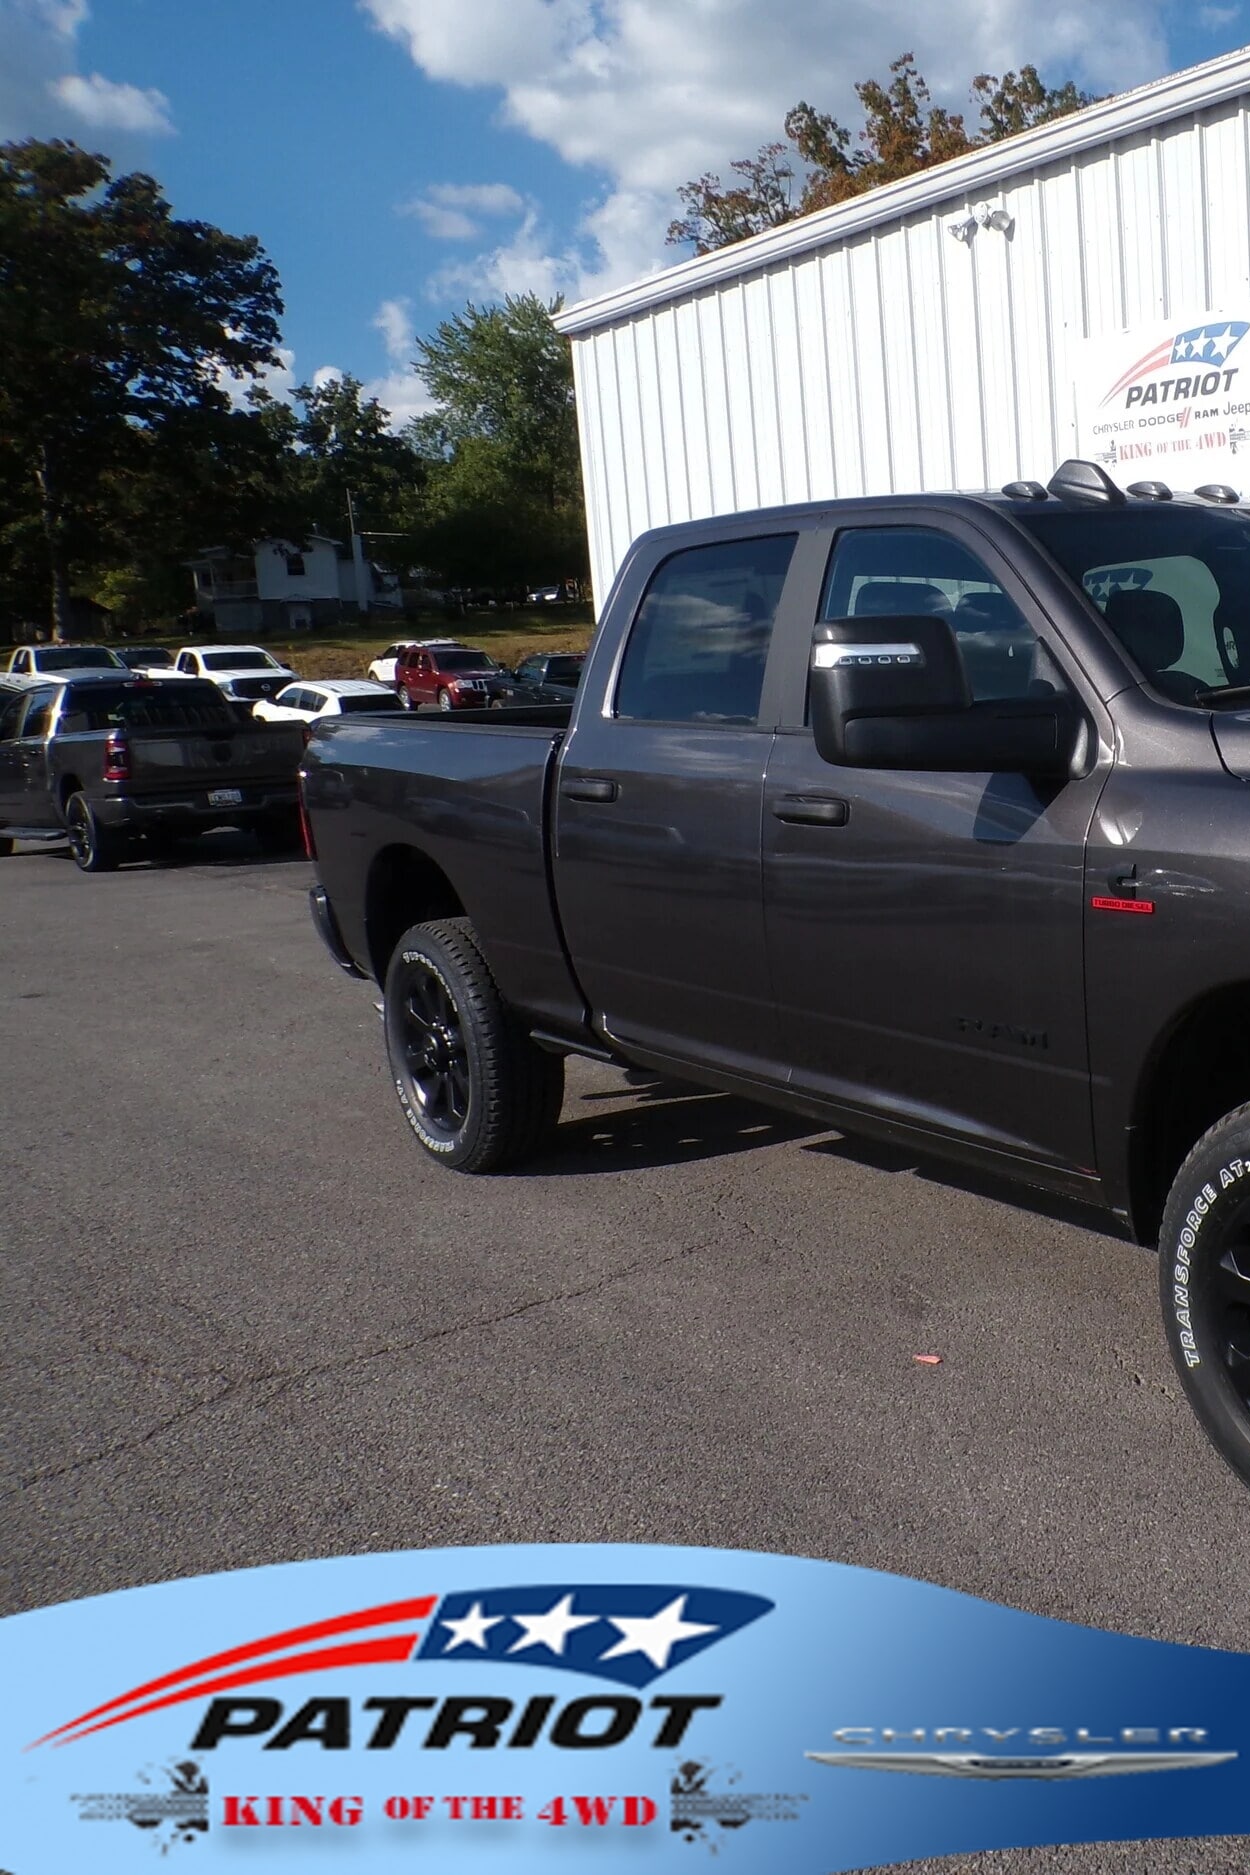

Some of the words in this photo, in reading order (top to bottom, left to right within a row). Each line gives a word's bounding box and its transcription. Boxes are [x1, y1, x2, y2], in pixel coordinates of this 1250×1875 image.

[1125, 368, 1239, 410] PATRIOT
[1093, 419, 1135, 435] CHRYSLER
[1138, 412, 1185, 428] DODGE
[1194, 408, 1219, 420] RAM
[1119, 442, 1153, 461] KING
[1156, 443, 1168, 454] OF
[1171, 438, 1192, 453] THE
[1195, 431, 1227, 450] 4WD
[1172, 1185, 1218, 1369] TRANSFORCE
